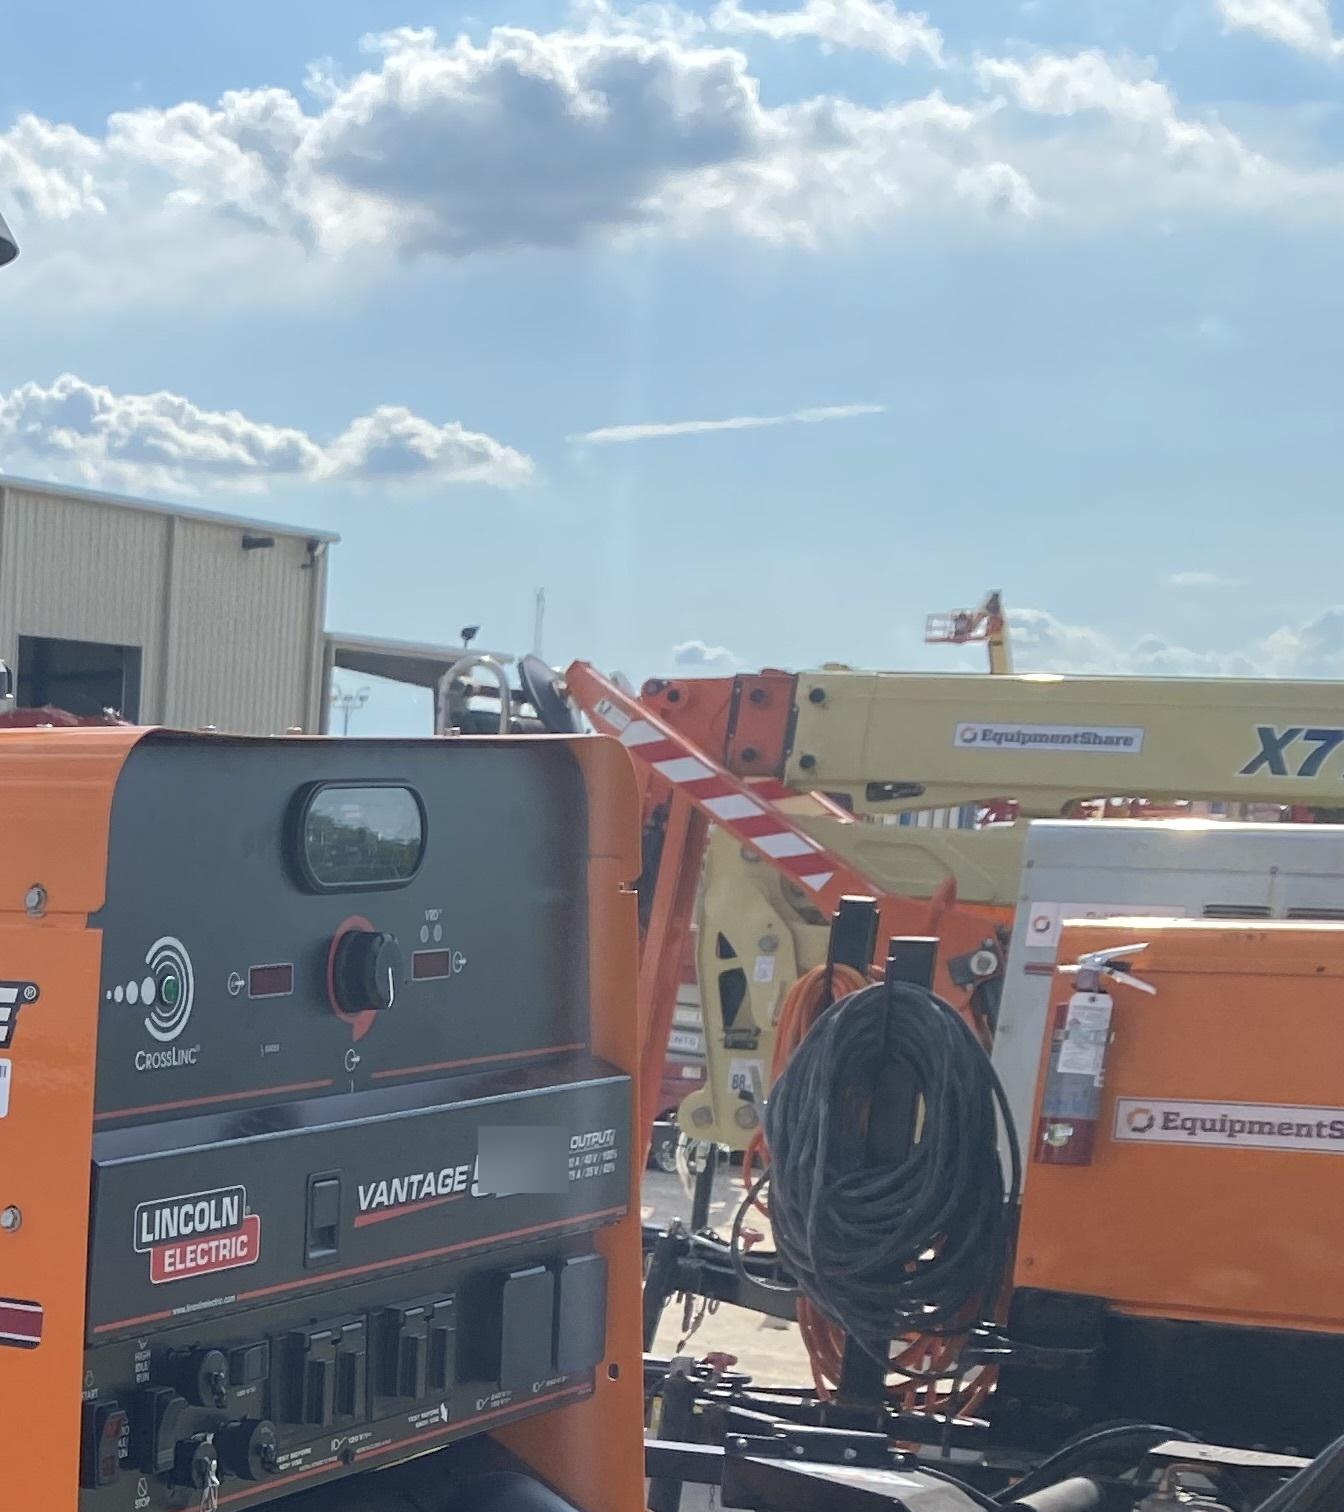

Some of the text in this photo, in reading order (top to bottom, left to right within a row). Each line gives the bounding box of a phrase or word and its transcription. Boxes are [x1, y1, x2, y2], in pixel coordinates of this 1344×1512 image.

[980, 728, 1134, 748] EquipmentShare
[357, 1164, 471, 1211] VANTAGE
[141, 1195, 239, 1243] LINCOLN
[164, 1235, 248, 1273] ELECTRIC
